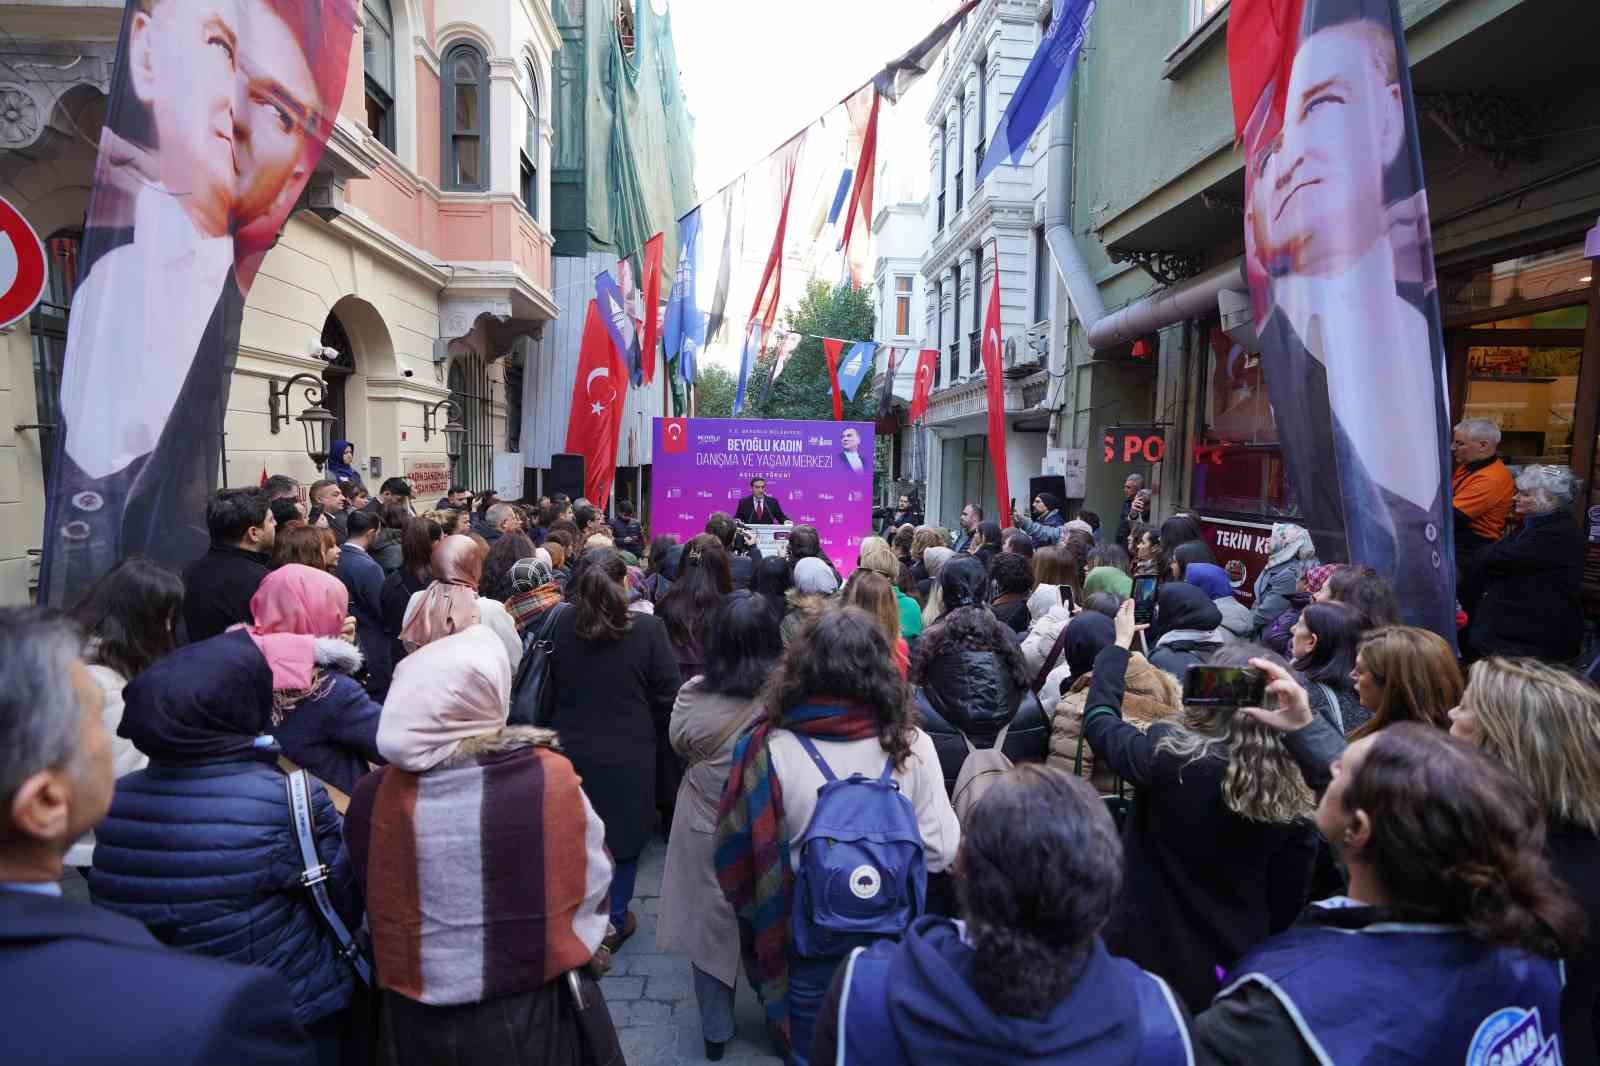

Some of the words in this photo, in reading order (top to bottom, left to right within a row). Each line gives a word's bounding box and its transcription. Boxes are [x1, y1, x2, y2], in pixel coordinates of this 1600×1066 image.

[727, 436, 771, 452] BEYOĞLU
[772, 439, 803, 453] KADIN
[696, 452, 738, 468] DANIŞMA
[742, 453, 754, 466] VE
[757, 454, 791, 469] YAŞAM
[792, 454, 833, 468] MERKEZİ
[1216, 530, 1252, 551] TEKİN
